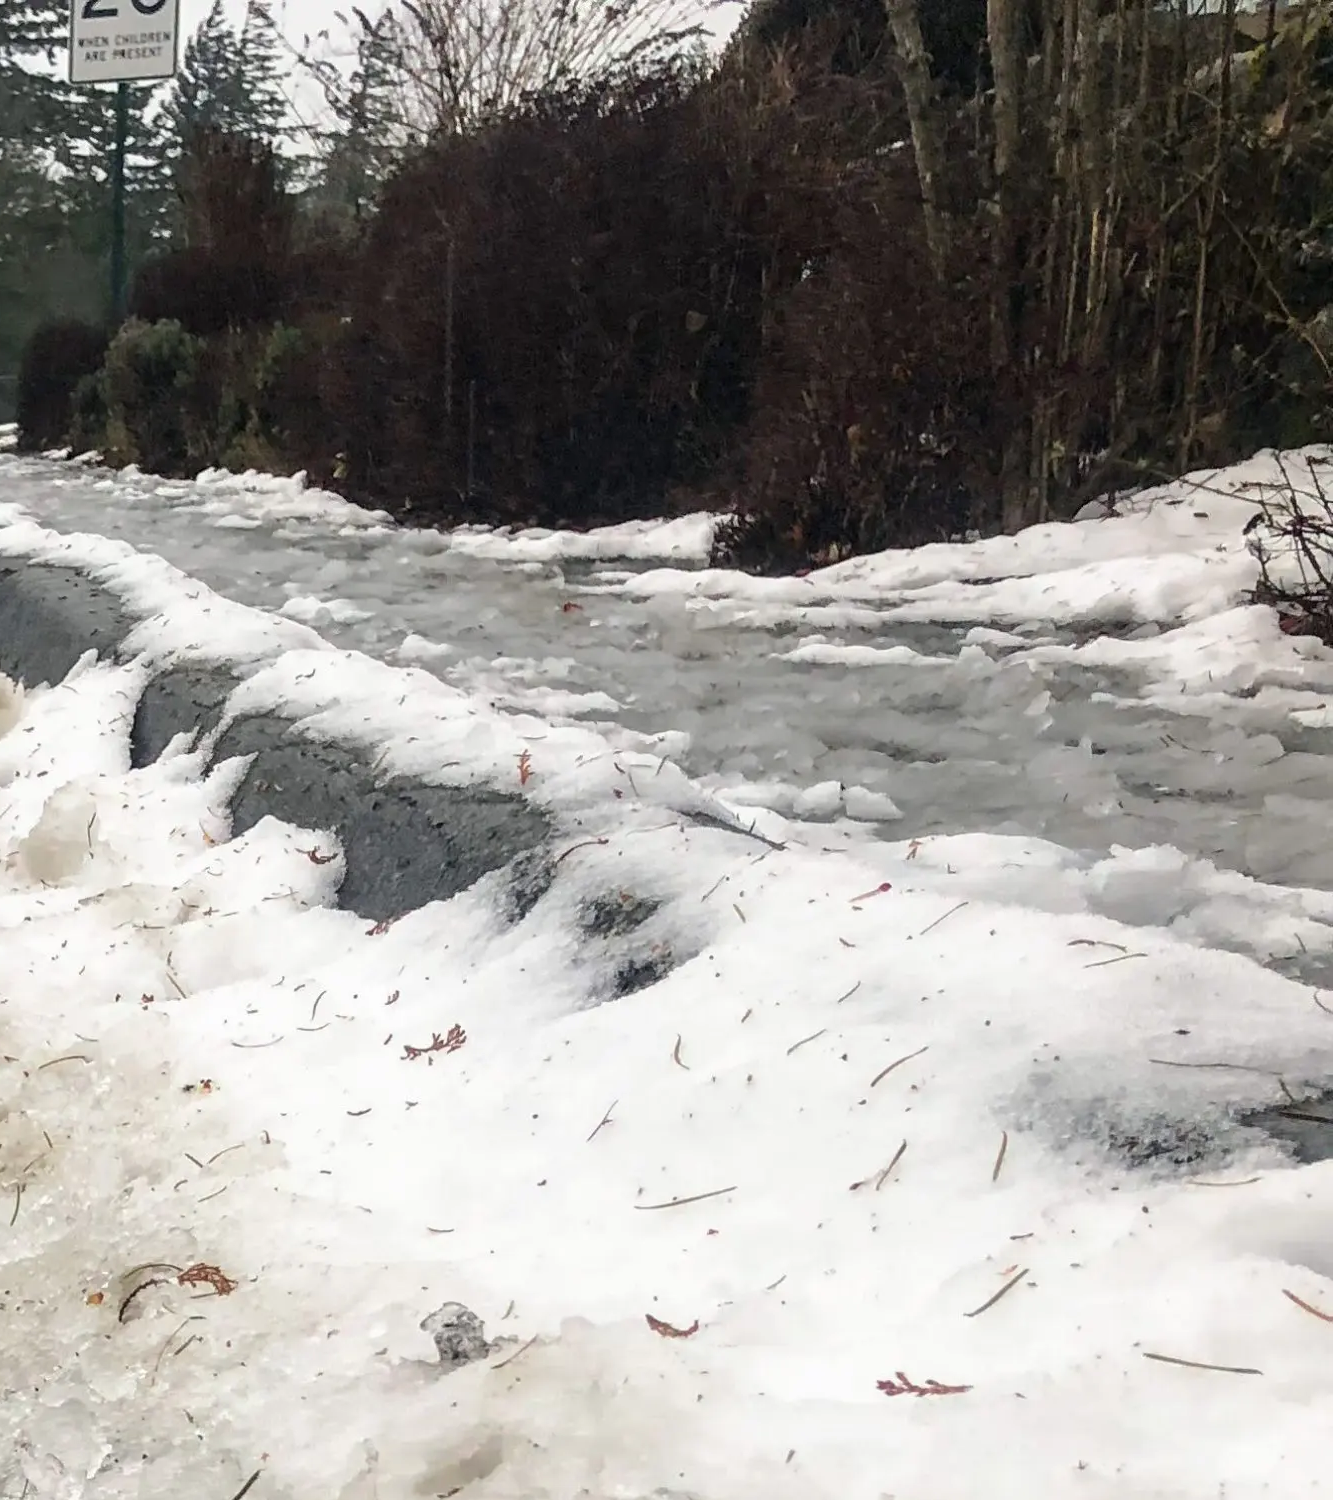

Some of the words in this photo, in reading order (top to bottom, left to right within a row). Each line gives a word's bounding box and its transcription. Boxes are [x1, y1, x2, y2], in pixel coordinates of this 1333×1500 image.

[78, 36, 109, 48] WHEN
[114, 31, 171, 46] CHILDREN
[85, 51, 107, 62] ARE
[112, 46, 163, 60] PRESENT
